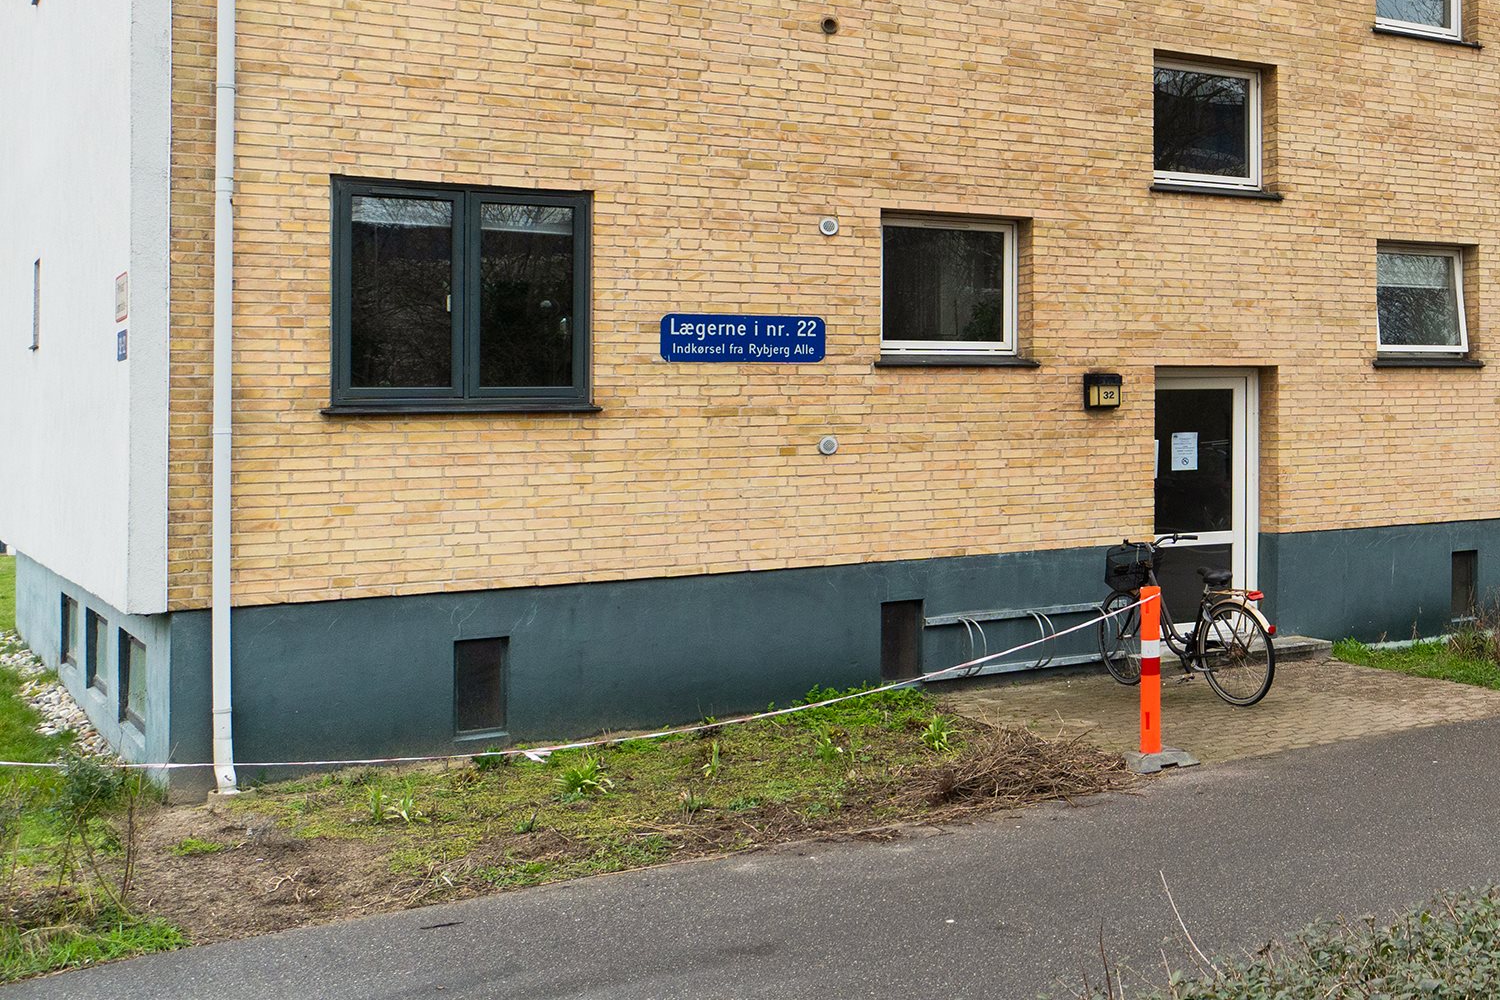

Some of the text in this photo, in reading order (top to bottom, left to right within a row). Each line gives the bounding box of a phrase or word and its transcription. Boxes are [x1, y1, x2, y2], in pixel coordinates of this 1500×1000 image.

[670, 318, 817, 341] Lægerne i nr. 22
[672, 343, 814, 357] Indkørsel fra Rybjerg Alle
[1103, 391, 1115, 399] 32
